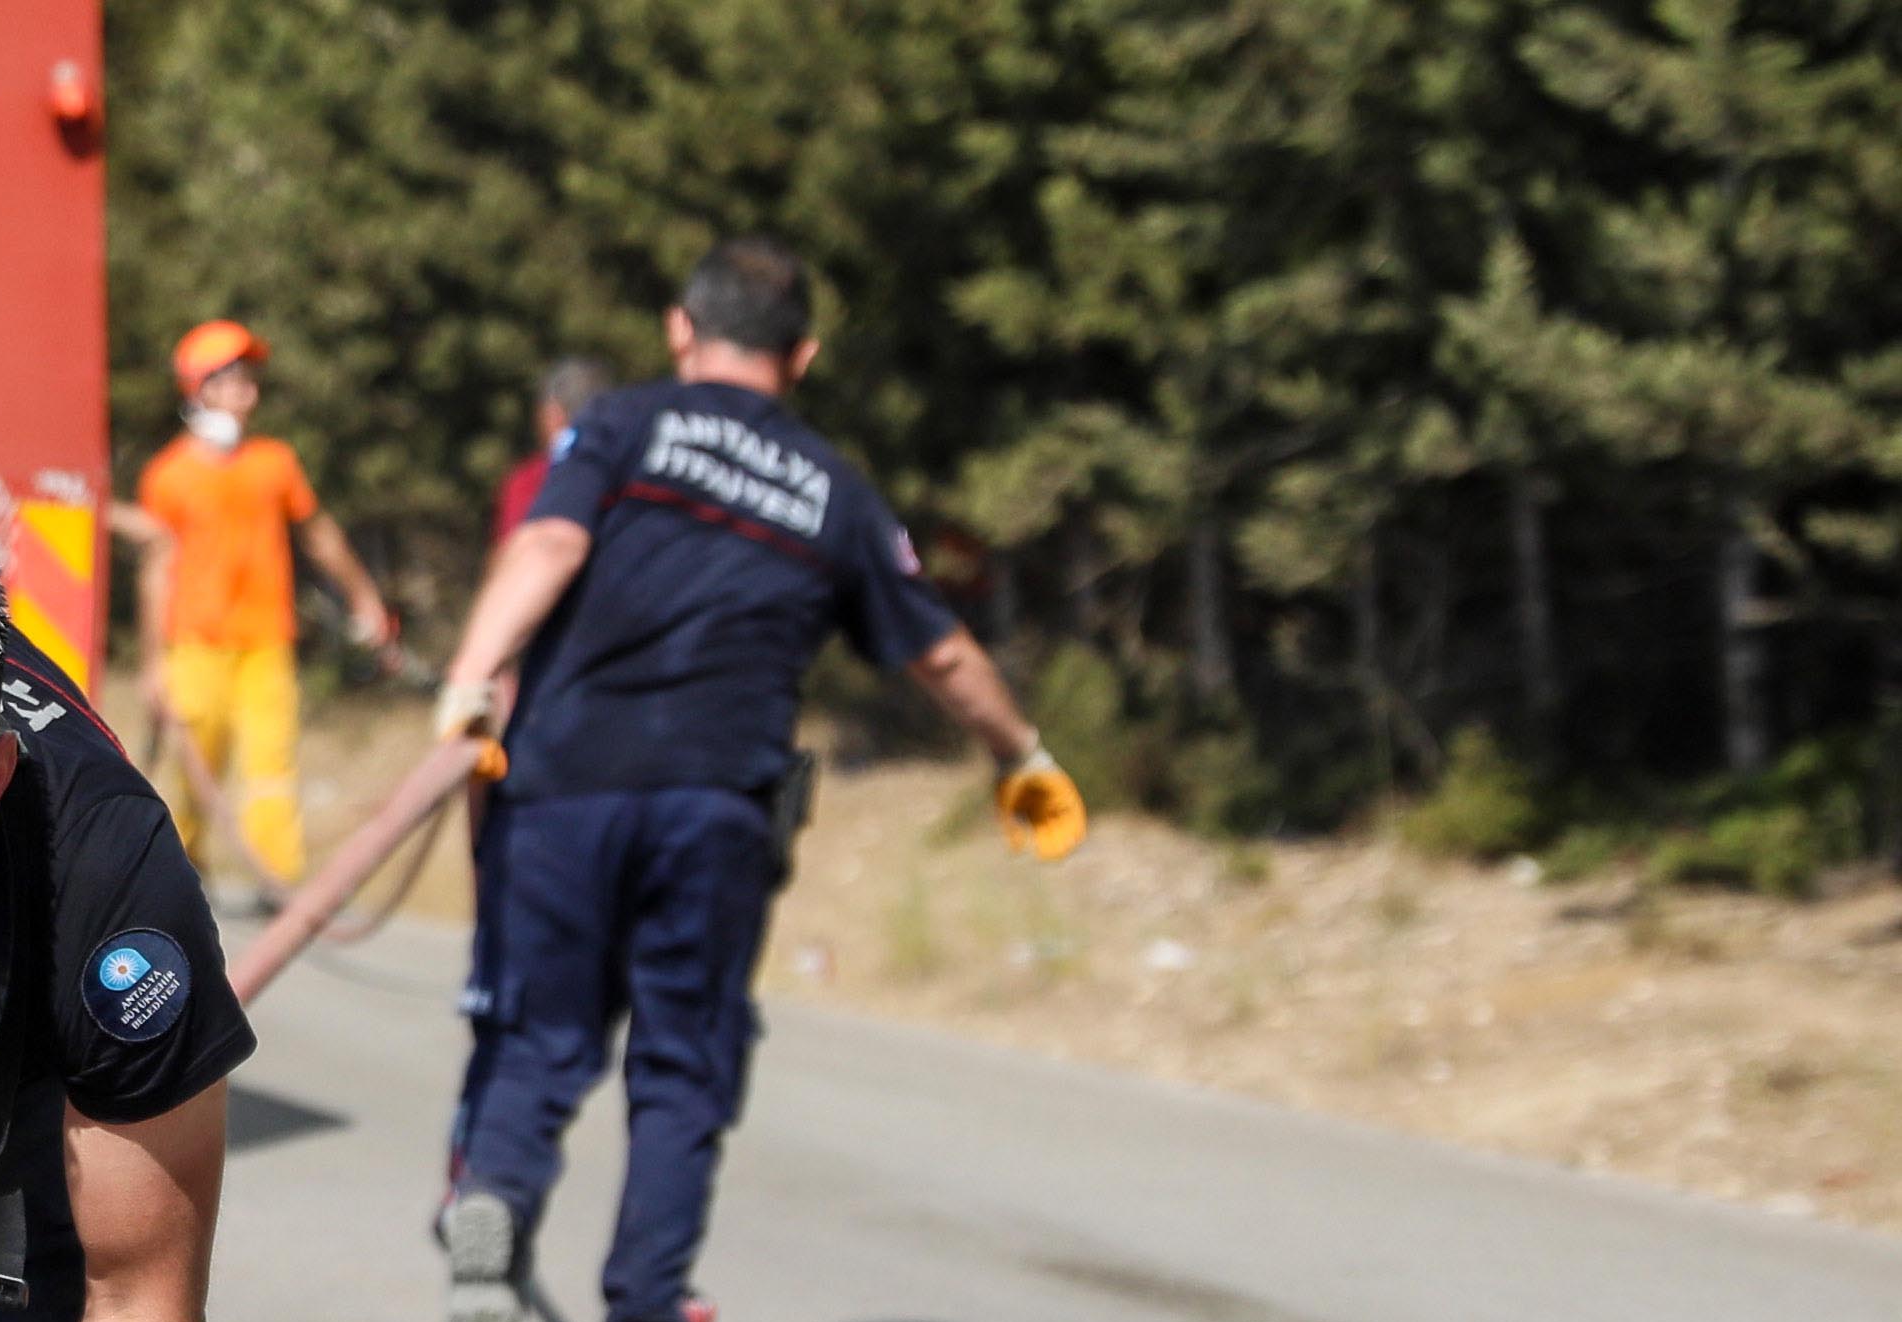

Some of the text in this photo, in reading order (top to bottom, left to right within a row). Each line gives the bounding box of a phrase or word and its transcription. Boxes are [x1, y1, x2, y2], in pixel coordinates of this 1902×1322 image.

[655, 409, 831, 502] ANTALYA
[120, 970, 176, 1025] BÜYÜKŞEHİR
[121, 970, 163, 1011] ANTALYA
[131, 978, 181, 1030] BELEDİYESİ
